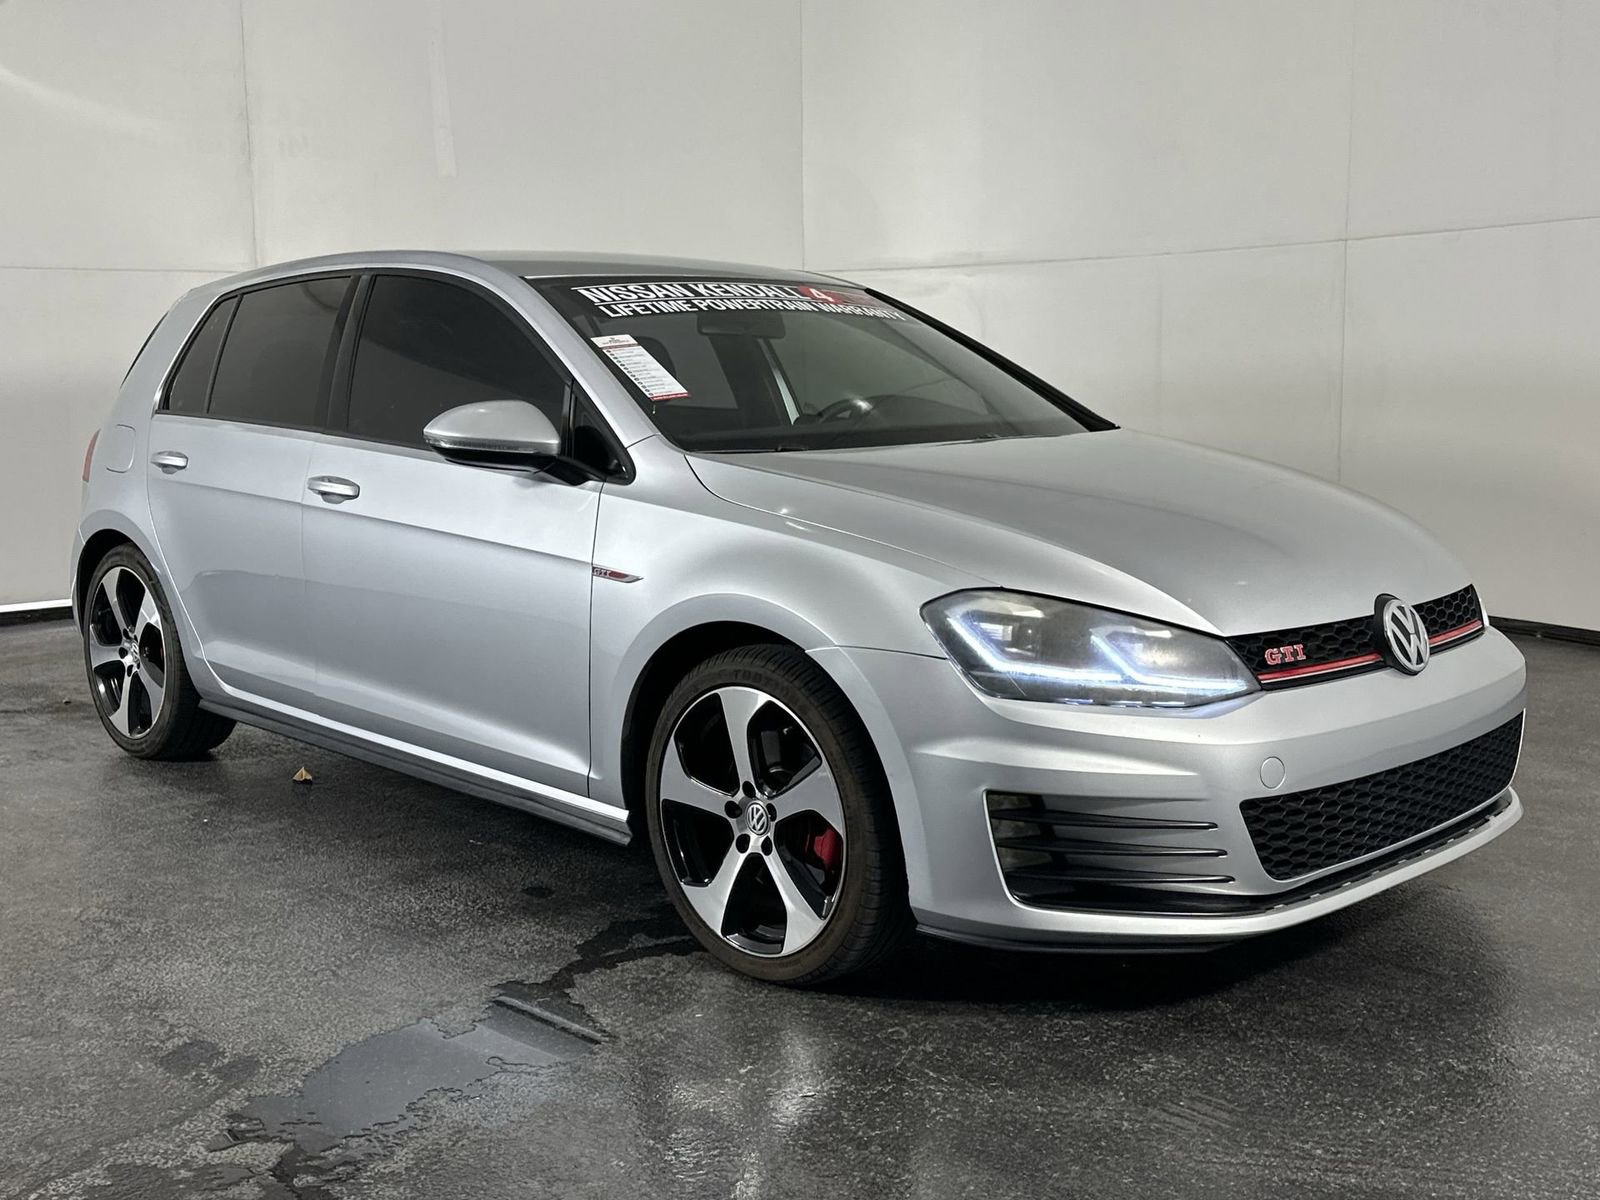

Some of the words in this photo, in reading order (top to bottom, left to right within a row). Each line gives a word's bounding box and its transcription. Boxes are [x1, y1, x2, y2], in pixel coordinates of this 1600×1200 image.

[577, 284, 694, 303] NISSAN
[689, 283, 812, 299] KENDALL
[598, 299, 698, 318] LIFETIME
[693, 298, 819, 313] POWERTRAIN
[1384, 599, 1430, 673] VW
[1264, 644, 1307, 665] GTI
